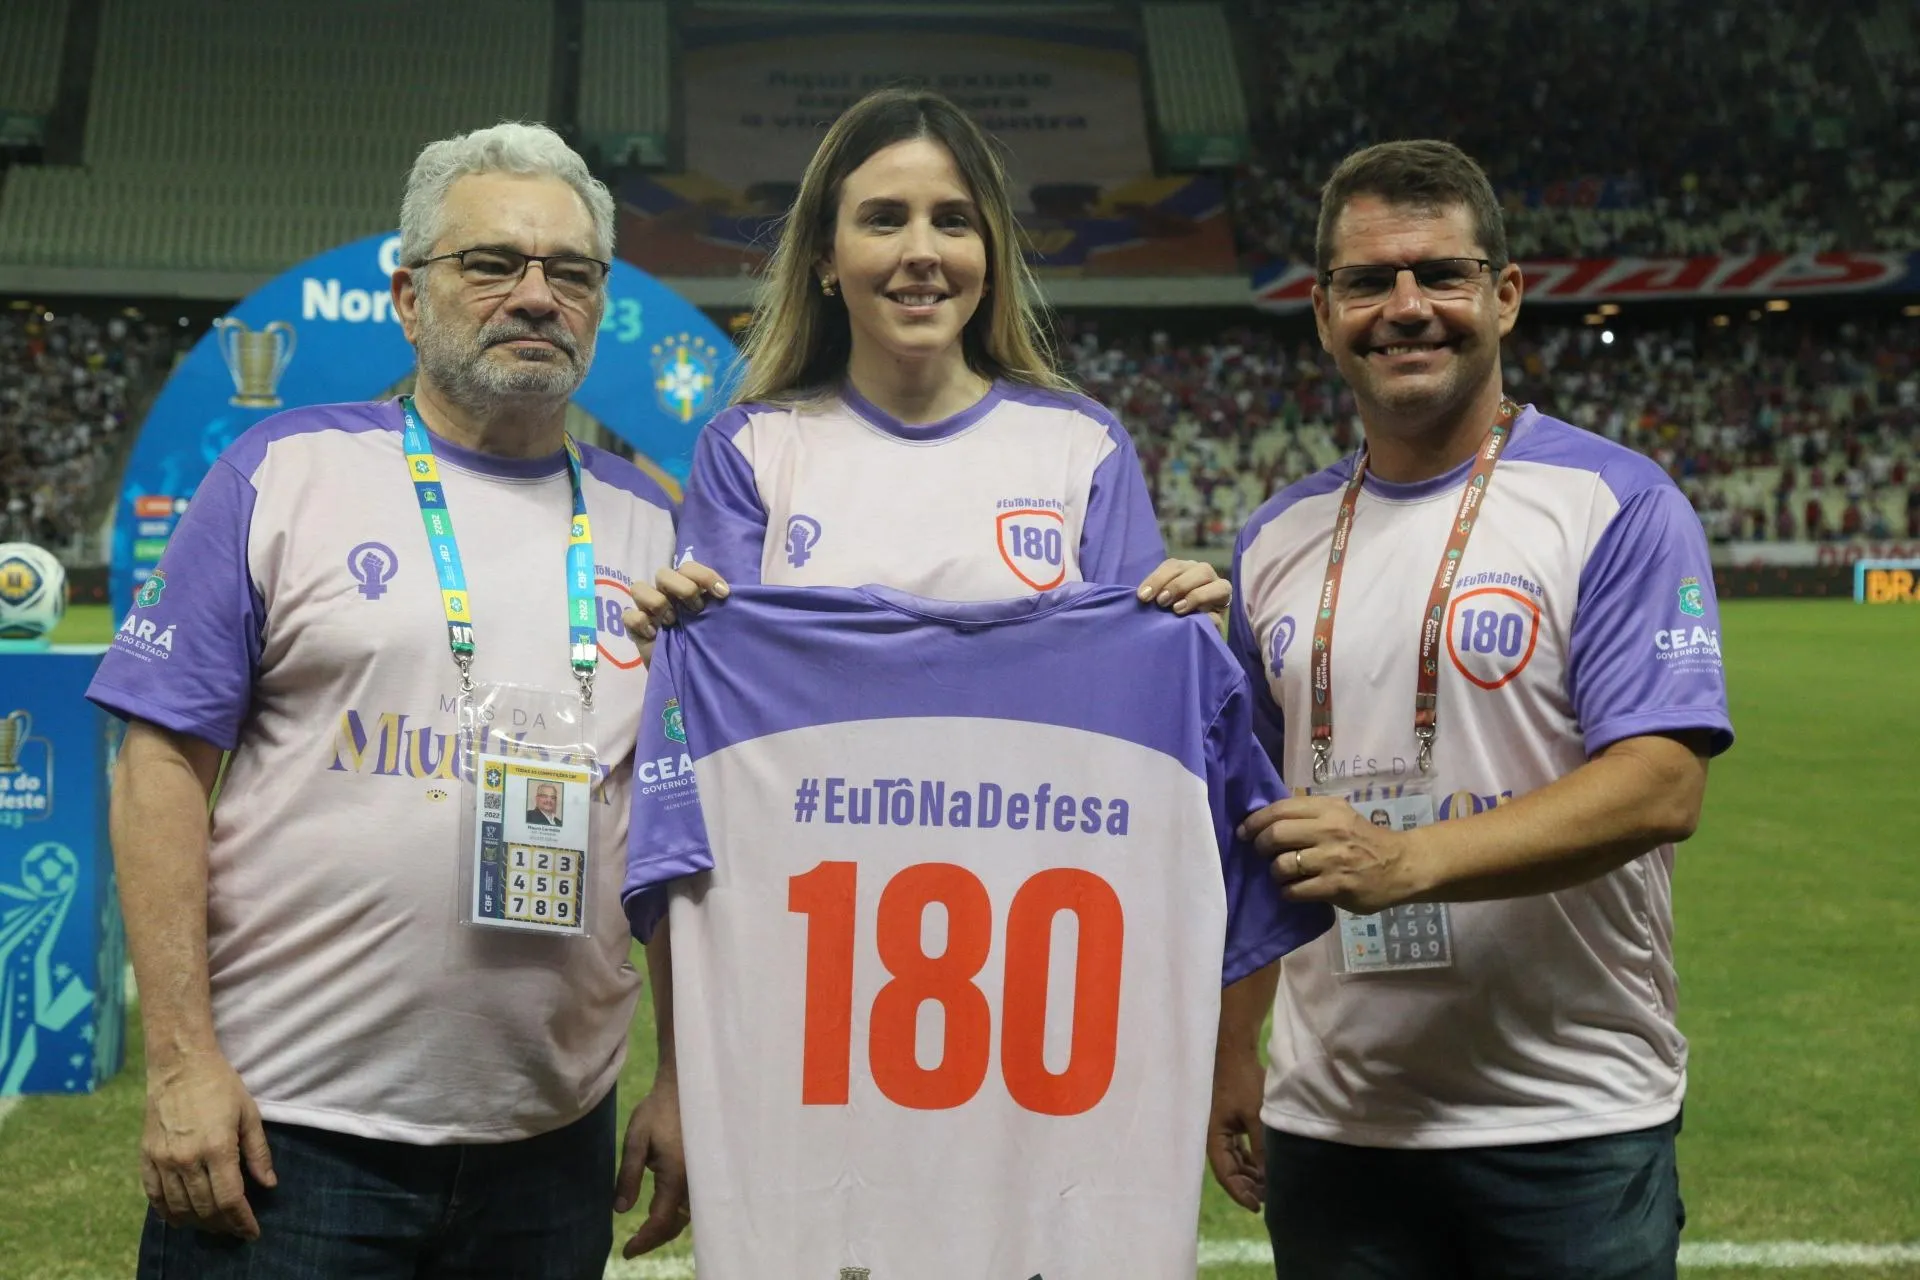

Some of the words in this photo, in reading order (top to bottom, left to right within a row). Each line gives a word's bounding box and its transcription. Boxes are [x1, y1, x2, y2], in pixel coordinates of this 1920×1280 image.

[440, 544, 452, 563] CBF
[1009, 524, 1062, 566] 180
[577, 571, 588, 589] CBF
[1456, 572, 1544, 597] #EuTôNaDefesa
[578, 599, 588, 620] 2022
[595, 595, 633, 640] 18
[120, 614, 177, 652] ARÁ
[1461, 609, 1524, 658] 180
[135, 640, 169, 660] ESTADO
[1656, 647, 1700, 660] GOVERNO
[512, 708, 547, 730] DA
[638, 753, 694, 784] CEA
[1332, 754, 1377, 778] MÊS
[642, 778, 688, 795] GOVERNO
[484, 811, 500, 819] 2022
[794, 777, 1130, 836] #EuTôNaDefesa
[516, 851, 525, 867] 1
[538, 854, 549, 869] 2
[560, 856, 570, 872] 3
[513, 874, 525, 890] 4
[537, 877, 547, 892] 5
[559, 880, 569, 895] 6
[484, 894, 492, 913] CBF
[513, 897, 523, 913] 7
[535, 900, 546, 916] 8
[557, 902, 568, 918] 9
[1389, 922, 1400, 938] 4
[1407, 920, 1418, 936] 5
[1426, 919, 1438, 935] 6
[1392, 942, 1401, 959] 7
[1410, 942, 1421, 959] 8
[1428, 941, 1440, 957] 9
[788, 860, 1125, 1117] 180
